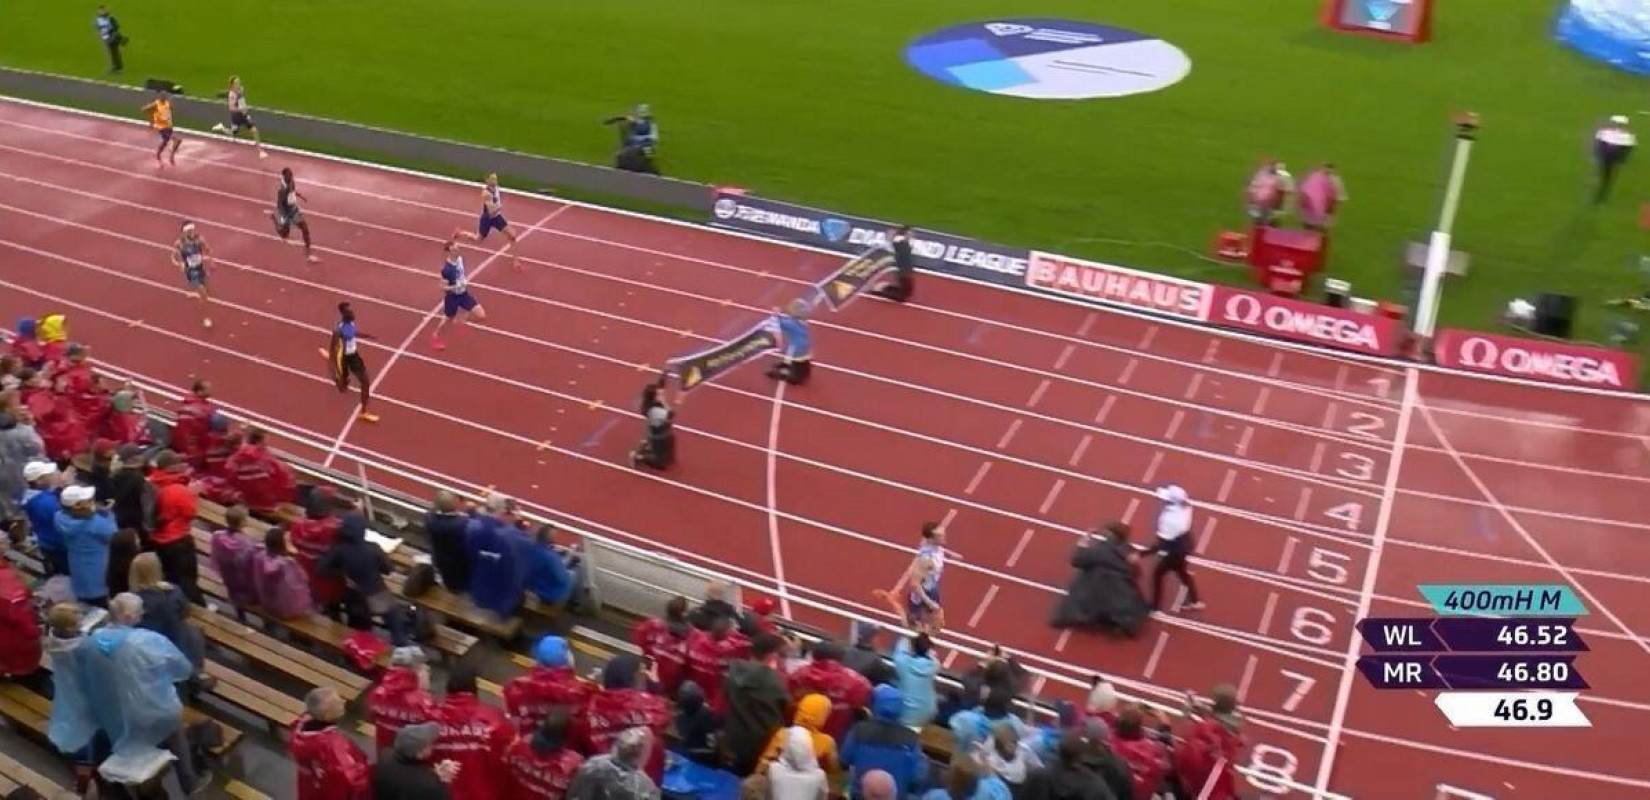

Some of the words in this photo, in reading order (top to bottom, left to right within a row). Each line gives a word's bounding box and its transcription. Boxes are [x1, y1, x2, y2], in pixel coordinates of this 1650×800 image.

[944, 245, 1028, 276] LEAGUE
[1033, 262, 1203, 313] BAUHAUS
[1265, 306, 1380, 351] OMEGA
[1501, 348, 1621, 387] OMEGA
[1367, 377, 1392, 399] 1
[1348, 411, 1386, 440] 2
[1336, 452, 1376, 482] 3
[1325, 502, 1364, 531] 4
[1307, 547, 1352, 585] 5
[1290, 606, 1336, 646] 6
[1280, 669, 1317, 712] 7
[1245, 743, 1298, 794] 8
